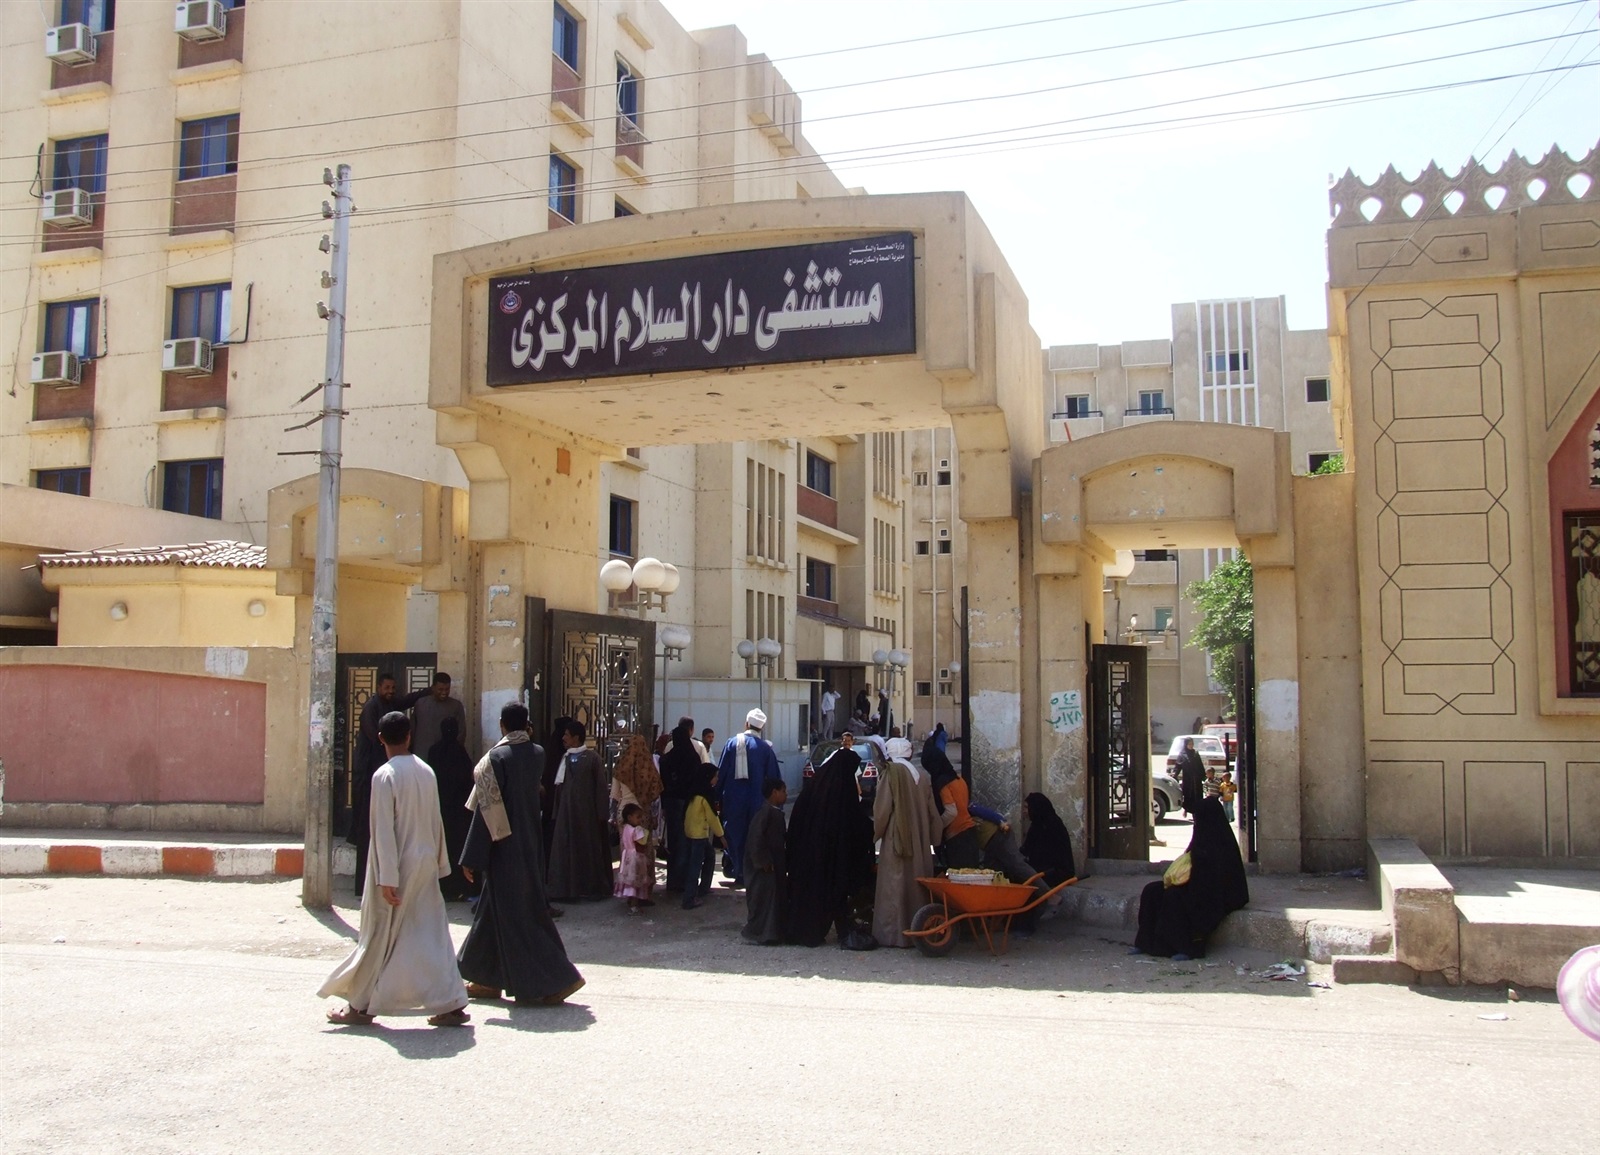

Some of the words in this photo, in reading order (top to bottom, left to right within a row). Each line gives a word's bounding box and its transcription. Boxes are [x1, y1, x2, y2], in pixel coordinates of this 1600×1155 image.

[614, 281, 701, 365] السلام
[702, 278, 750, 354] دار
[755, 260, 883, 351] مستشفى
